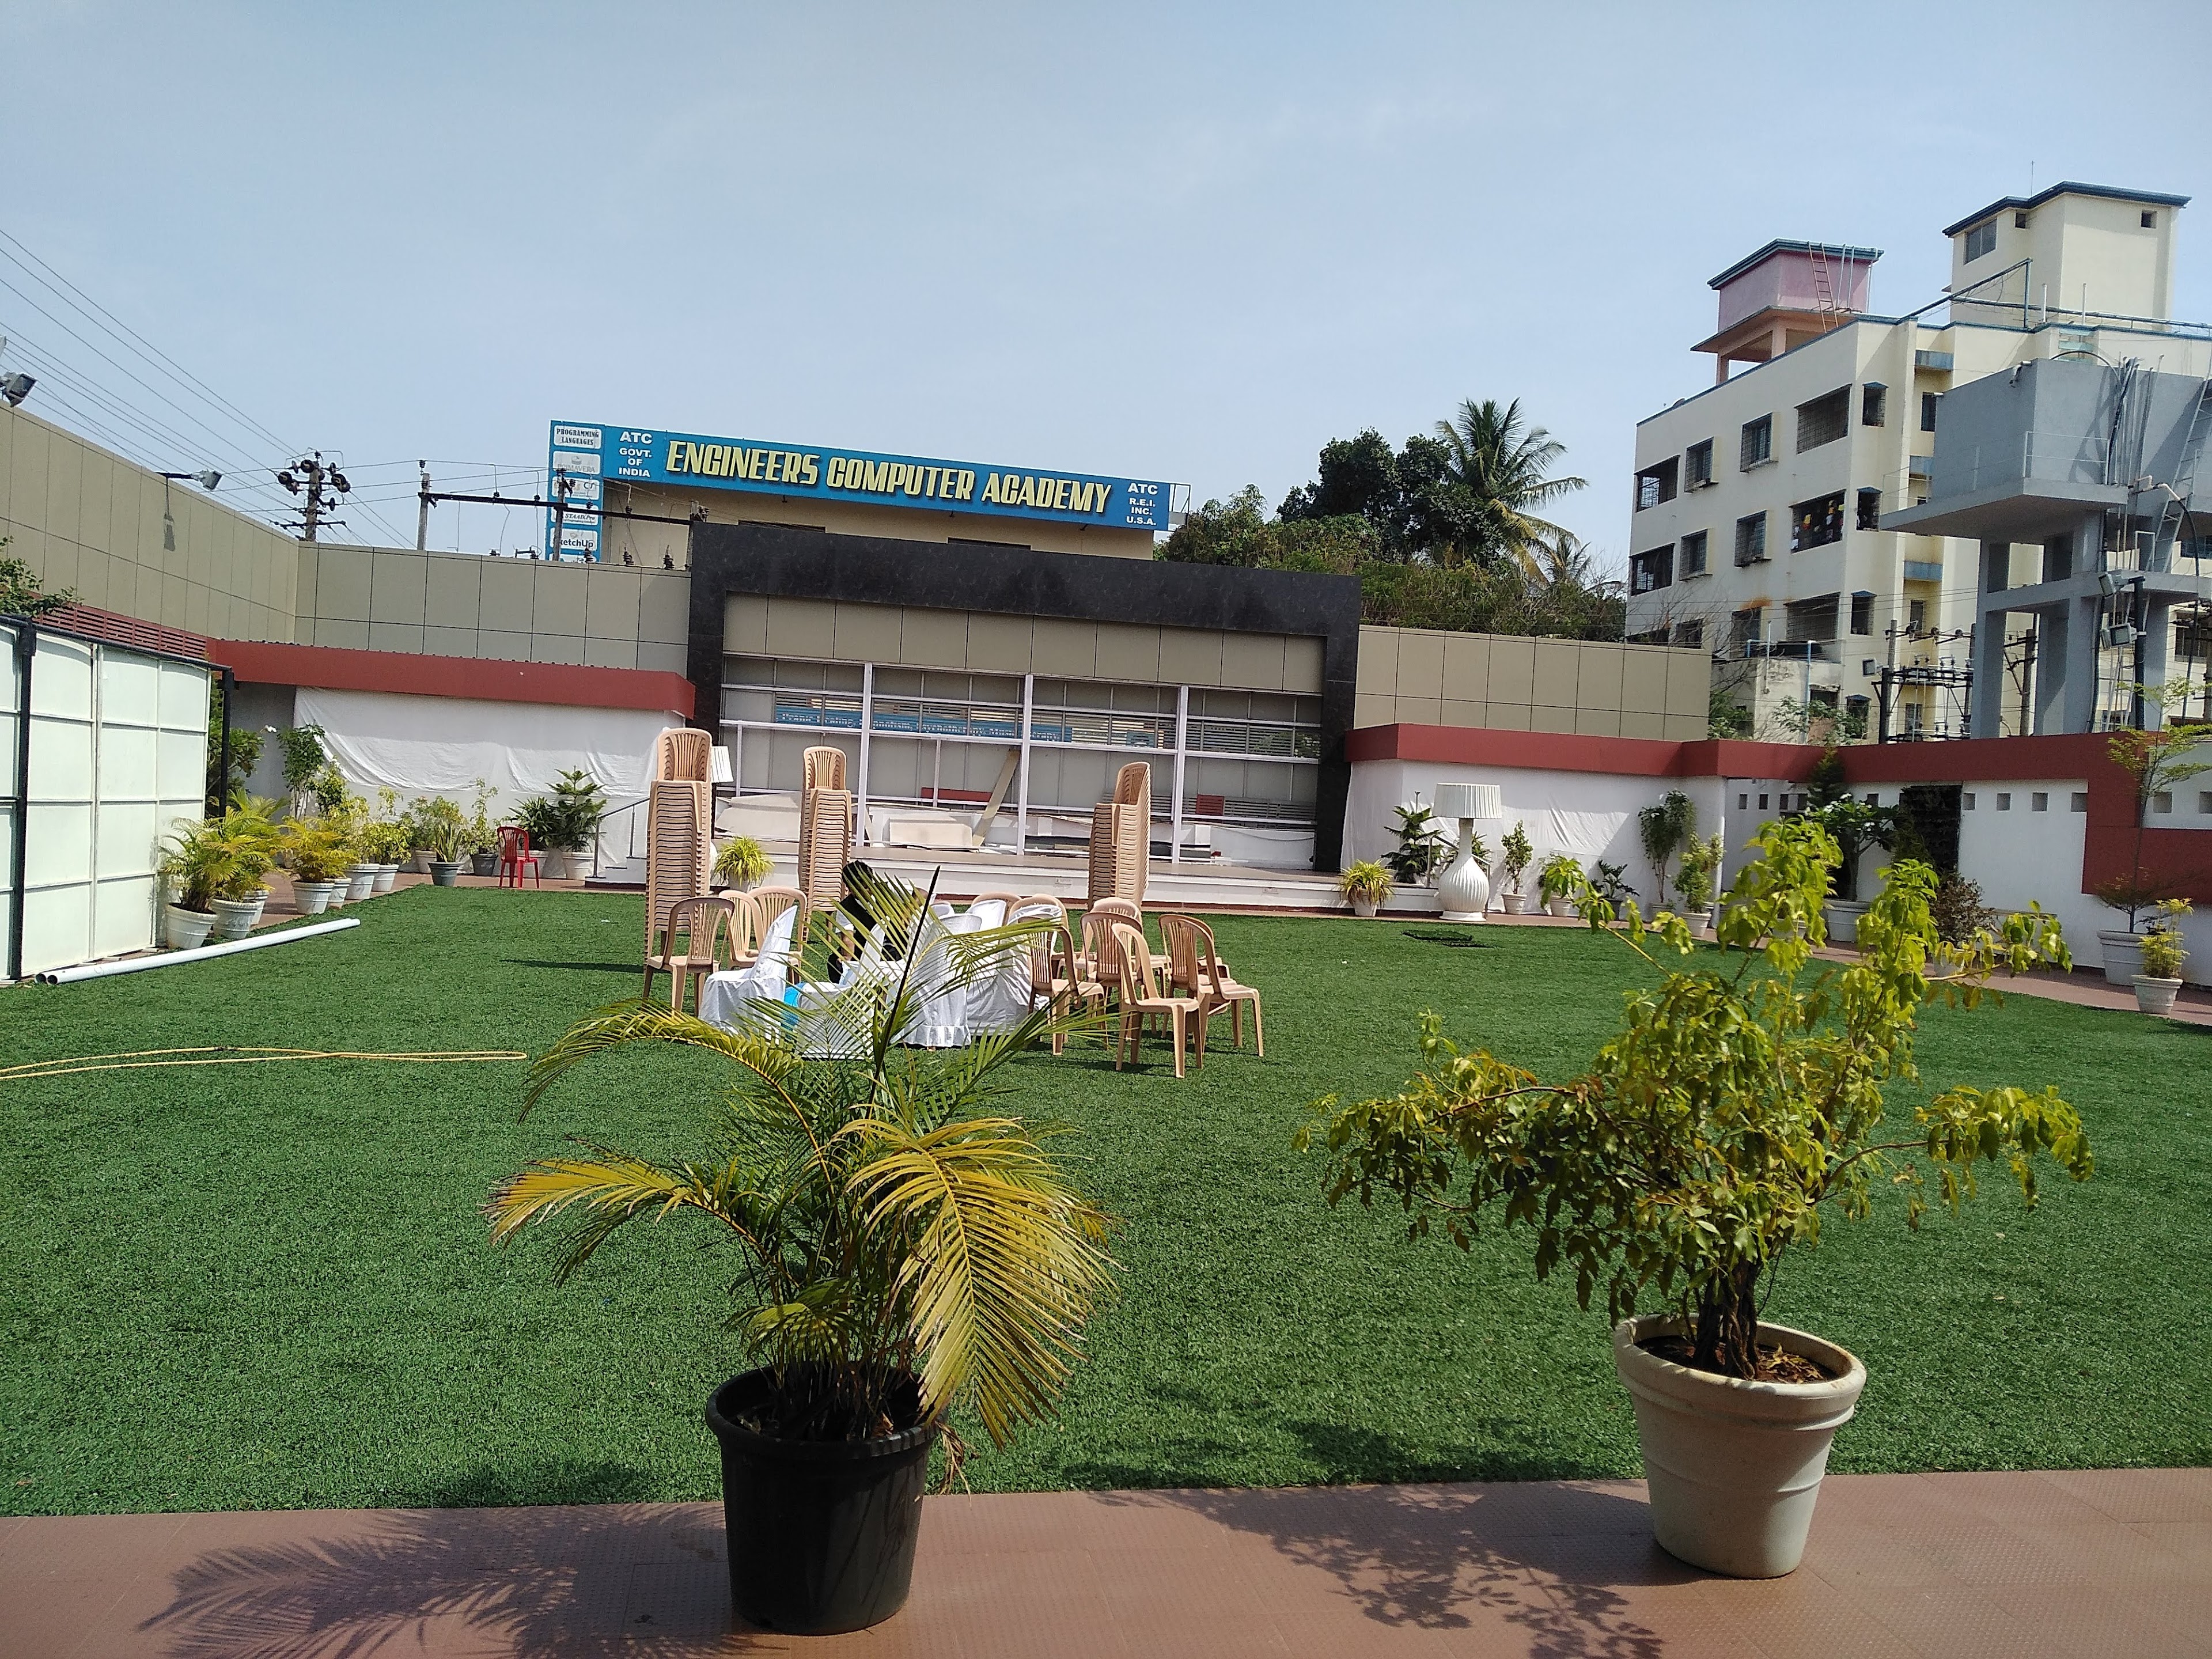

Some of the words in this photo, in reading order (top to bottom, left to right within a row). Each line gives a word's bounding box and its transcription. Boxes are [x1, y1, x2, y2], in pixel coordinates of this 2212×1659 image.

[556, 429, 599, 438] PROGRAMMING
[619, 431, 653, 444] ATC
[562, 437, 593, 445] LANGUAGES
[619, 447, 652, 458] GOVT.
[627, 458, 643, 467] OF
[557, 464, 595, 473] PRIMAVERA
[619, 468, 650, 478] INDIA
[666, 440, 821, 485] ENGINEERS
[826, 457, 975, 501] COMPUTER
[981, 472, 1112, 514] ACADEMY
[1127, 483, 1158, 495] ATC
[1128, 498, 1156, 507] R.E.I.
[1131, 507, 1153, 516] INC.
[1126, 517, 1157, 526] U.S.A.
